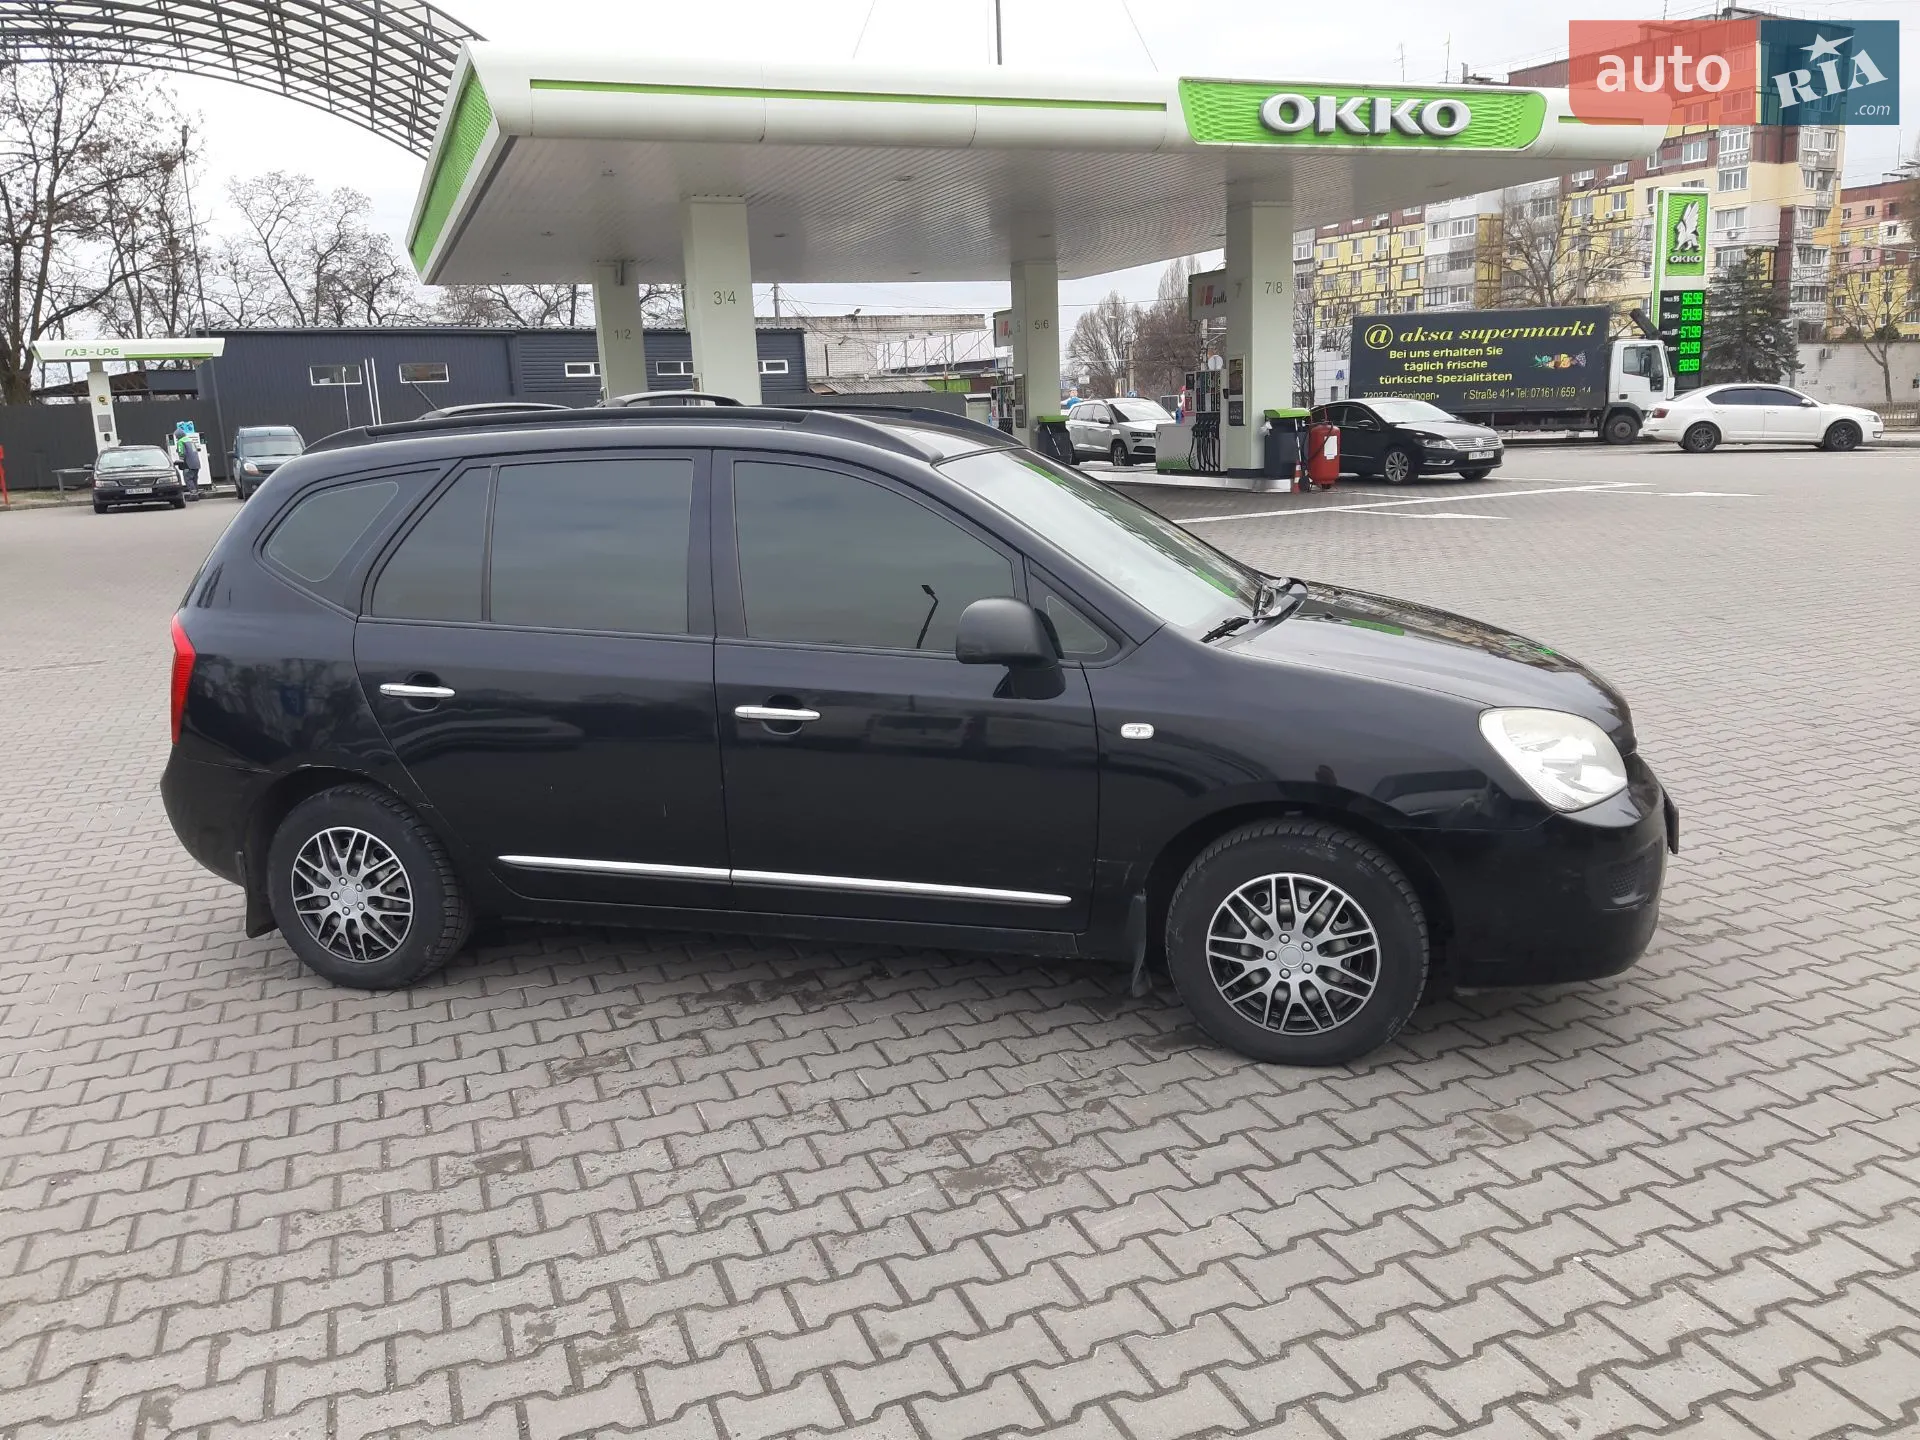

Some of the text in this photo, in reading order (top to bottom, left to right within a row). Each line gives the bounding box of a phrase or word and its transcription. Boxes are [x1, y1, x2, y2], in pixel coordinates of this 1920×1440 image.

[1259, 93, 1472, 136] OKKO
[1670, 255, 1703, 263] OKKO
[1399, 326, 1453, 342] aksa
[1459, 320, 1597, 344] supermarkt
[64, 348, 87, 357] ГАЗ
[96, 347, 120, 356] LPG
[1389, 346, 1503, 359] Bei uns erhalten Sie
[1404, 360, 1488, 372] täglich frische
[1379, 372, 1513, 385] türkische Spezialitäten
[1469, 388, 1498, 400] Straße
[1531, 387, 1554, 398] 07161
[1561, 387, 1576, 397] 659
